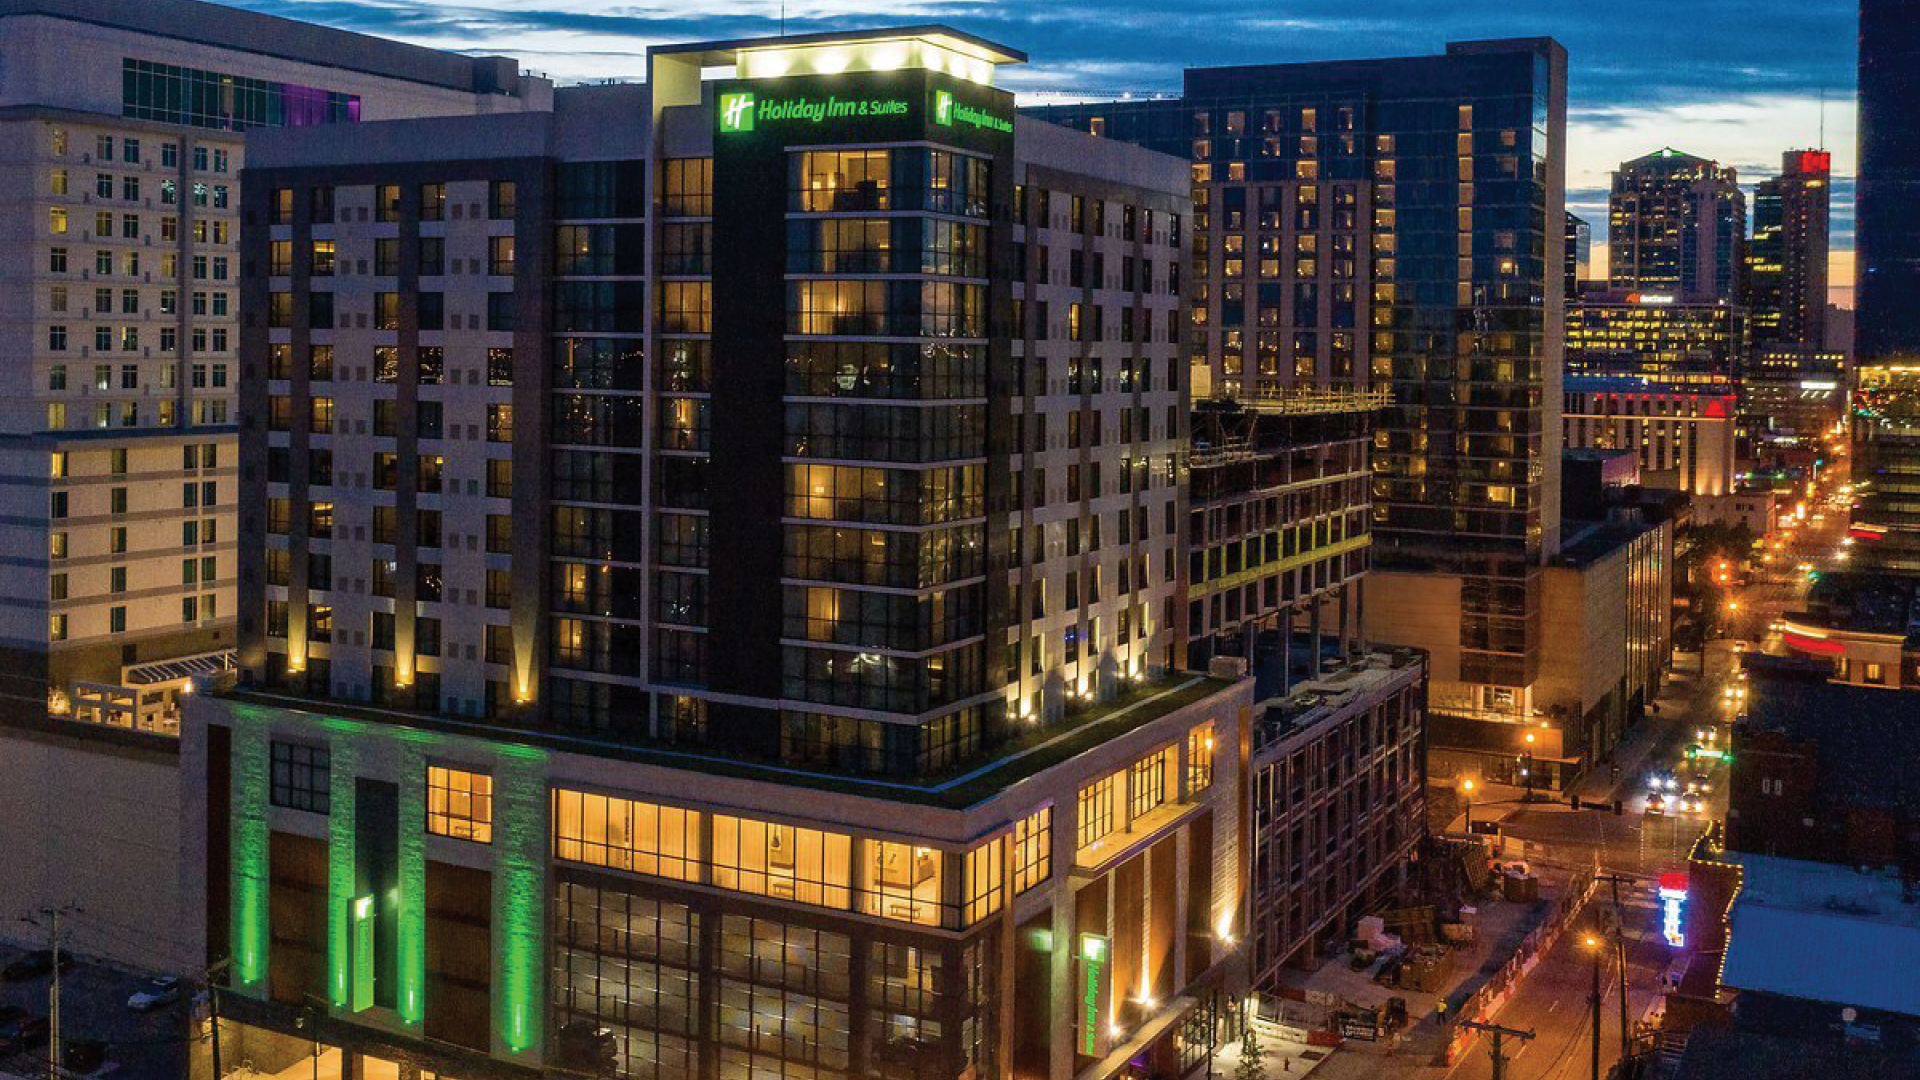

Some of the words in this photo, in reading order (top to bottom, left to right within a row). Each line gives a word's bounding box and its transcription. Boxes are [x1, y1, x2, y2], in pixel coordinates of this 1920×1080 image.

[758, 98, 826, 122] Holiday
[827, 96, 856, 116] Inn
[859, 101, 868, 115] &
[870, 100, 908, 115] Suites
[953, 102, 981, 129] Holiday
[1085, 962, 1099, 1005] Holiday
